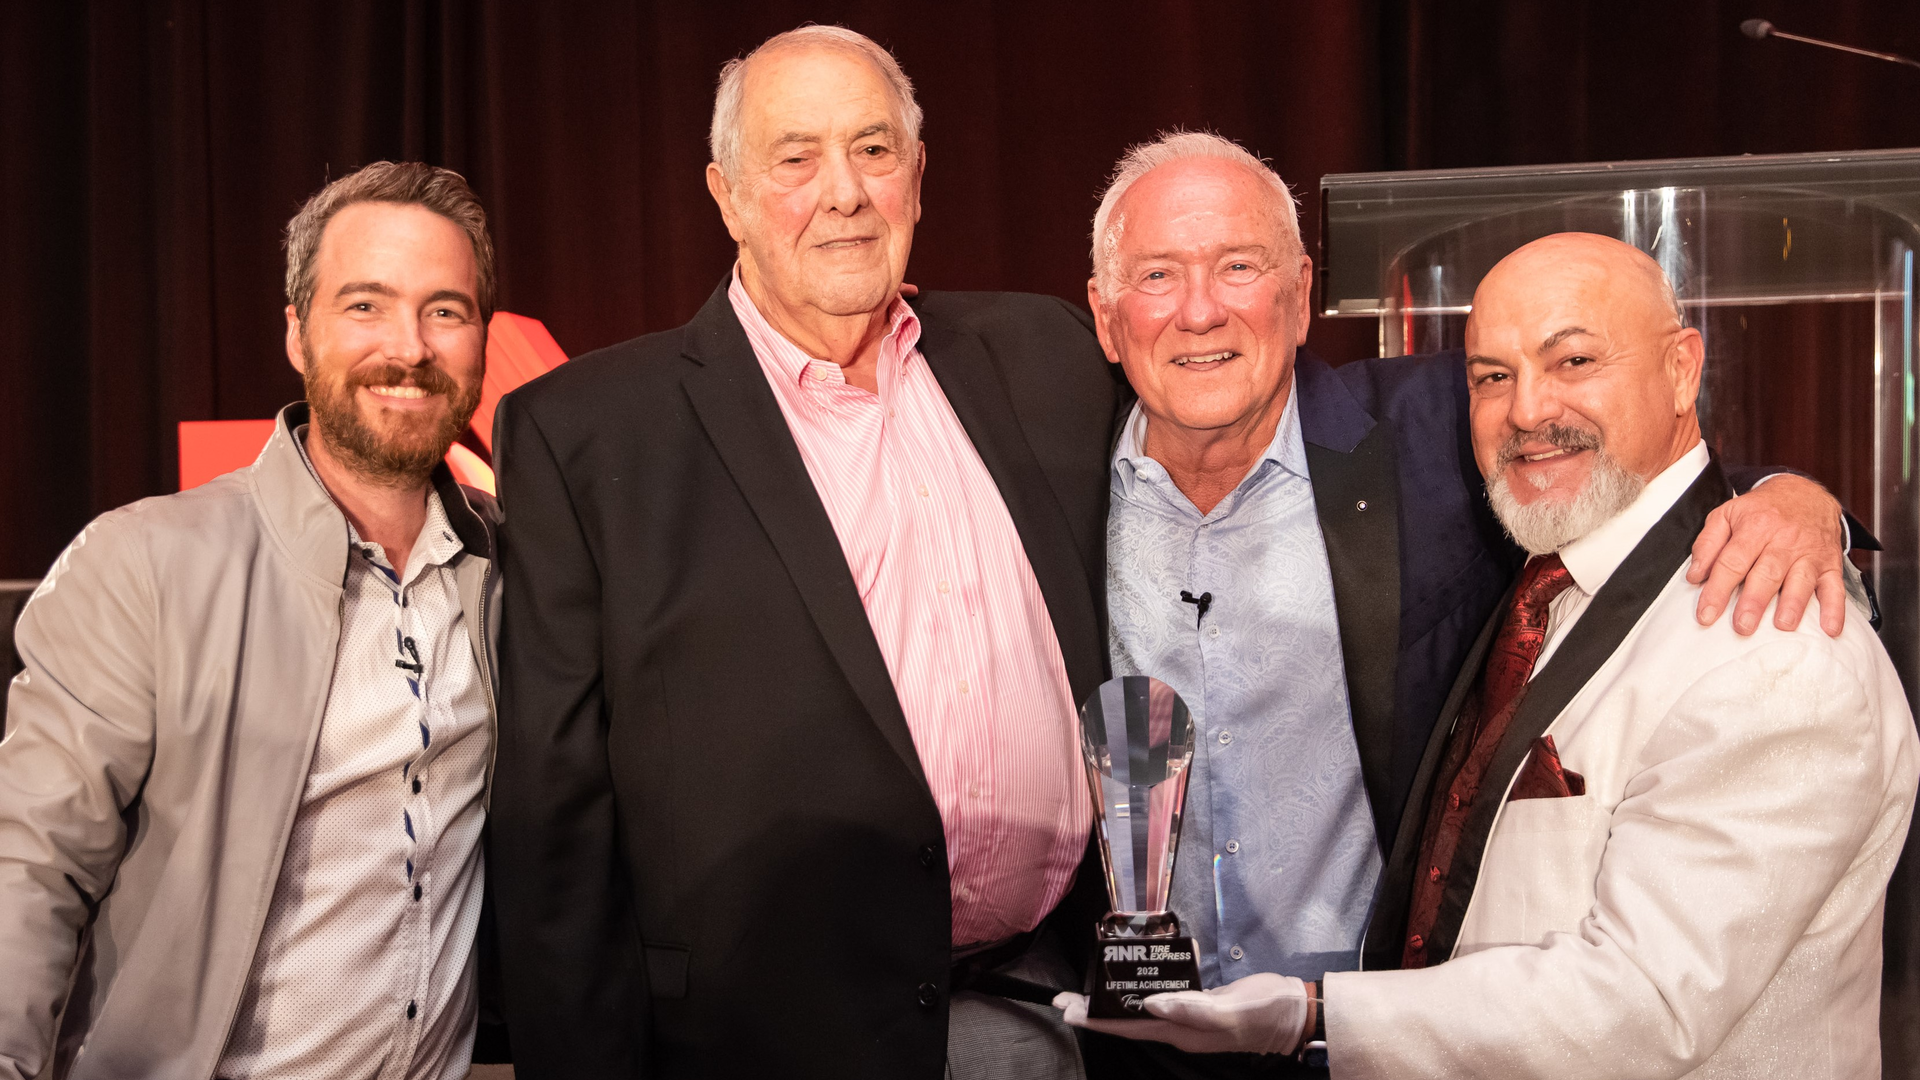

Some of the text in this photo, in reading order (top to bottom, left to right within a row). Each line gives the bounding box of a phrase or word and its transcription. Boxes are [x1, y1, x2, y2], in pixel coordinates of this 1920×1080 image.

[1150, 952, 1191, 961] EXPRESS
[1137, 967, 1159, 975] 2022
[1106, 980, 1190, 989] LIFETIME ACHIEVEMENT
[1121, 993, 1144, 1011] Tony
